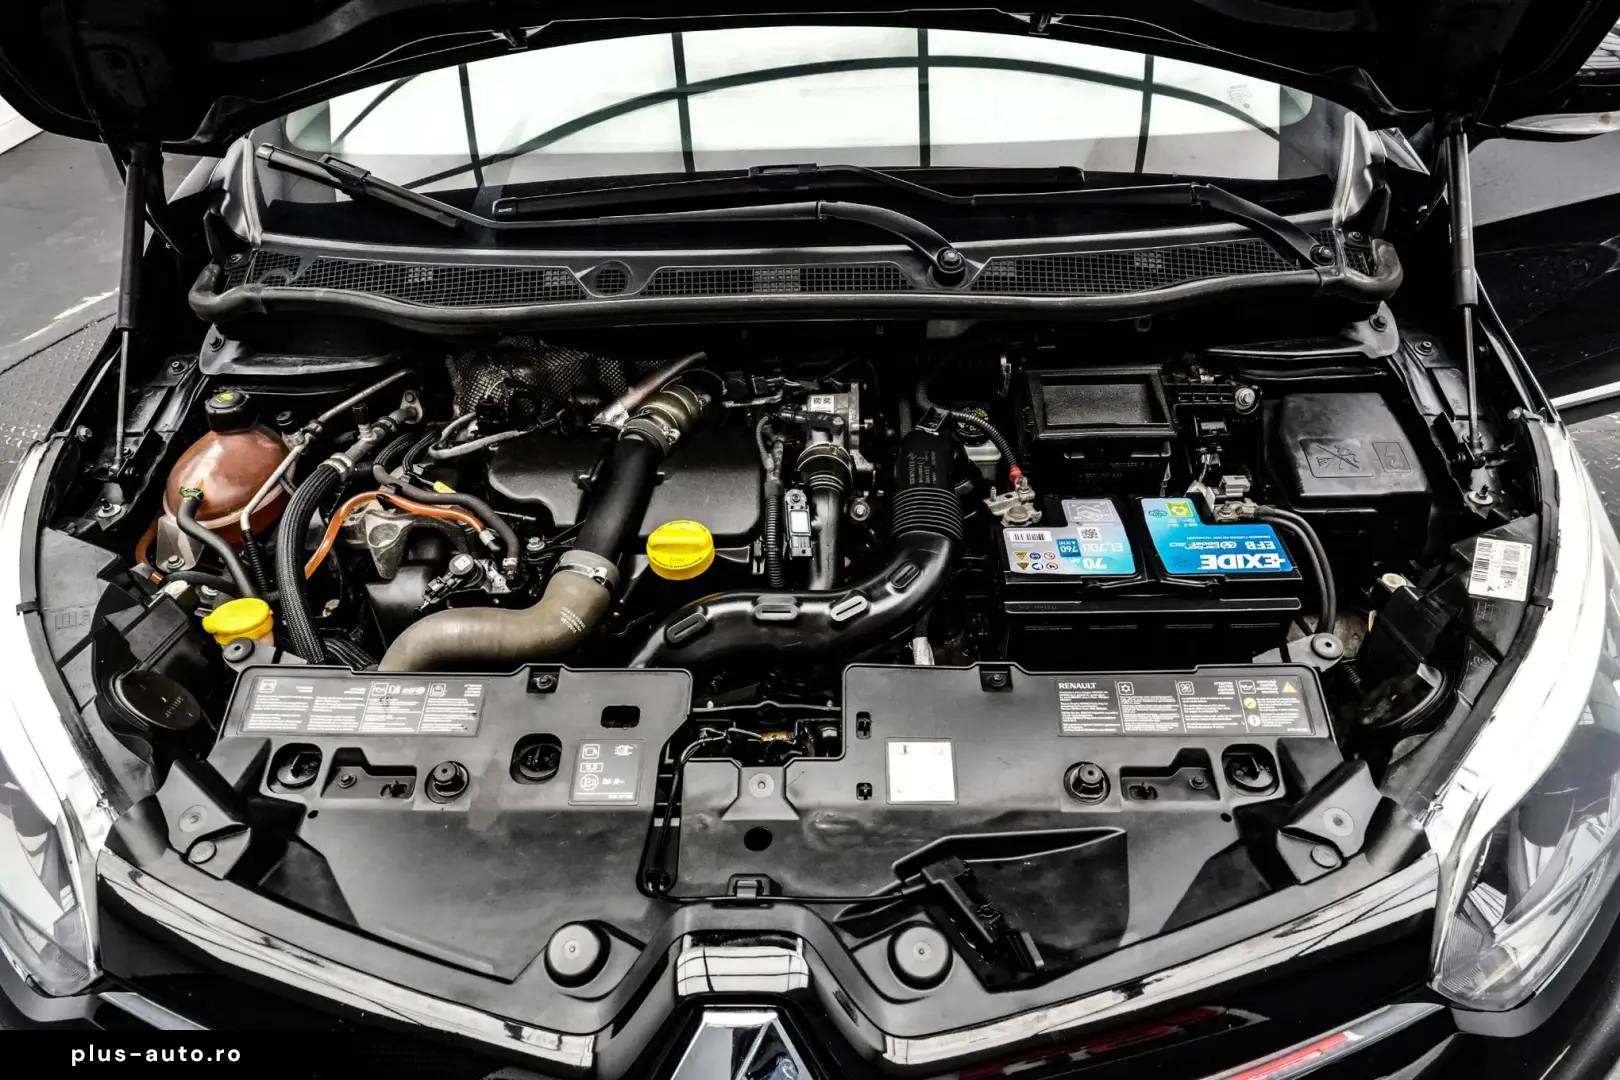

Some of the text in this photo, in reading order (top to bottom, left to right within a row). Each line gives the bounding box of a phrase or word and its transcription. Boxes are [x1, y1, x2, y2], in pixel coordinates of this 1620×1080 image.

[1060, 545, 1078, 553] 760
[1245, 541, 1276, 550] EFB
[1083, 557, 1107, 570] 70
[1200, 553, 1283, 570] EXIDE
